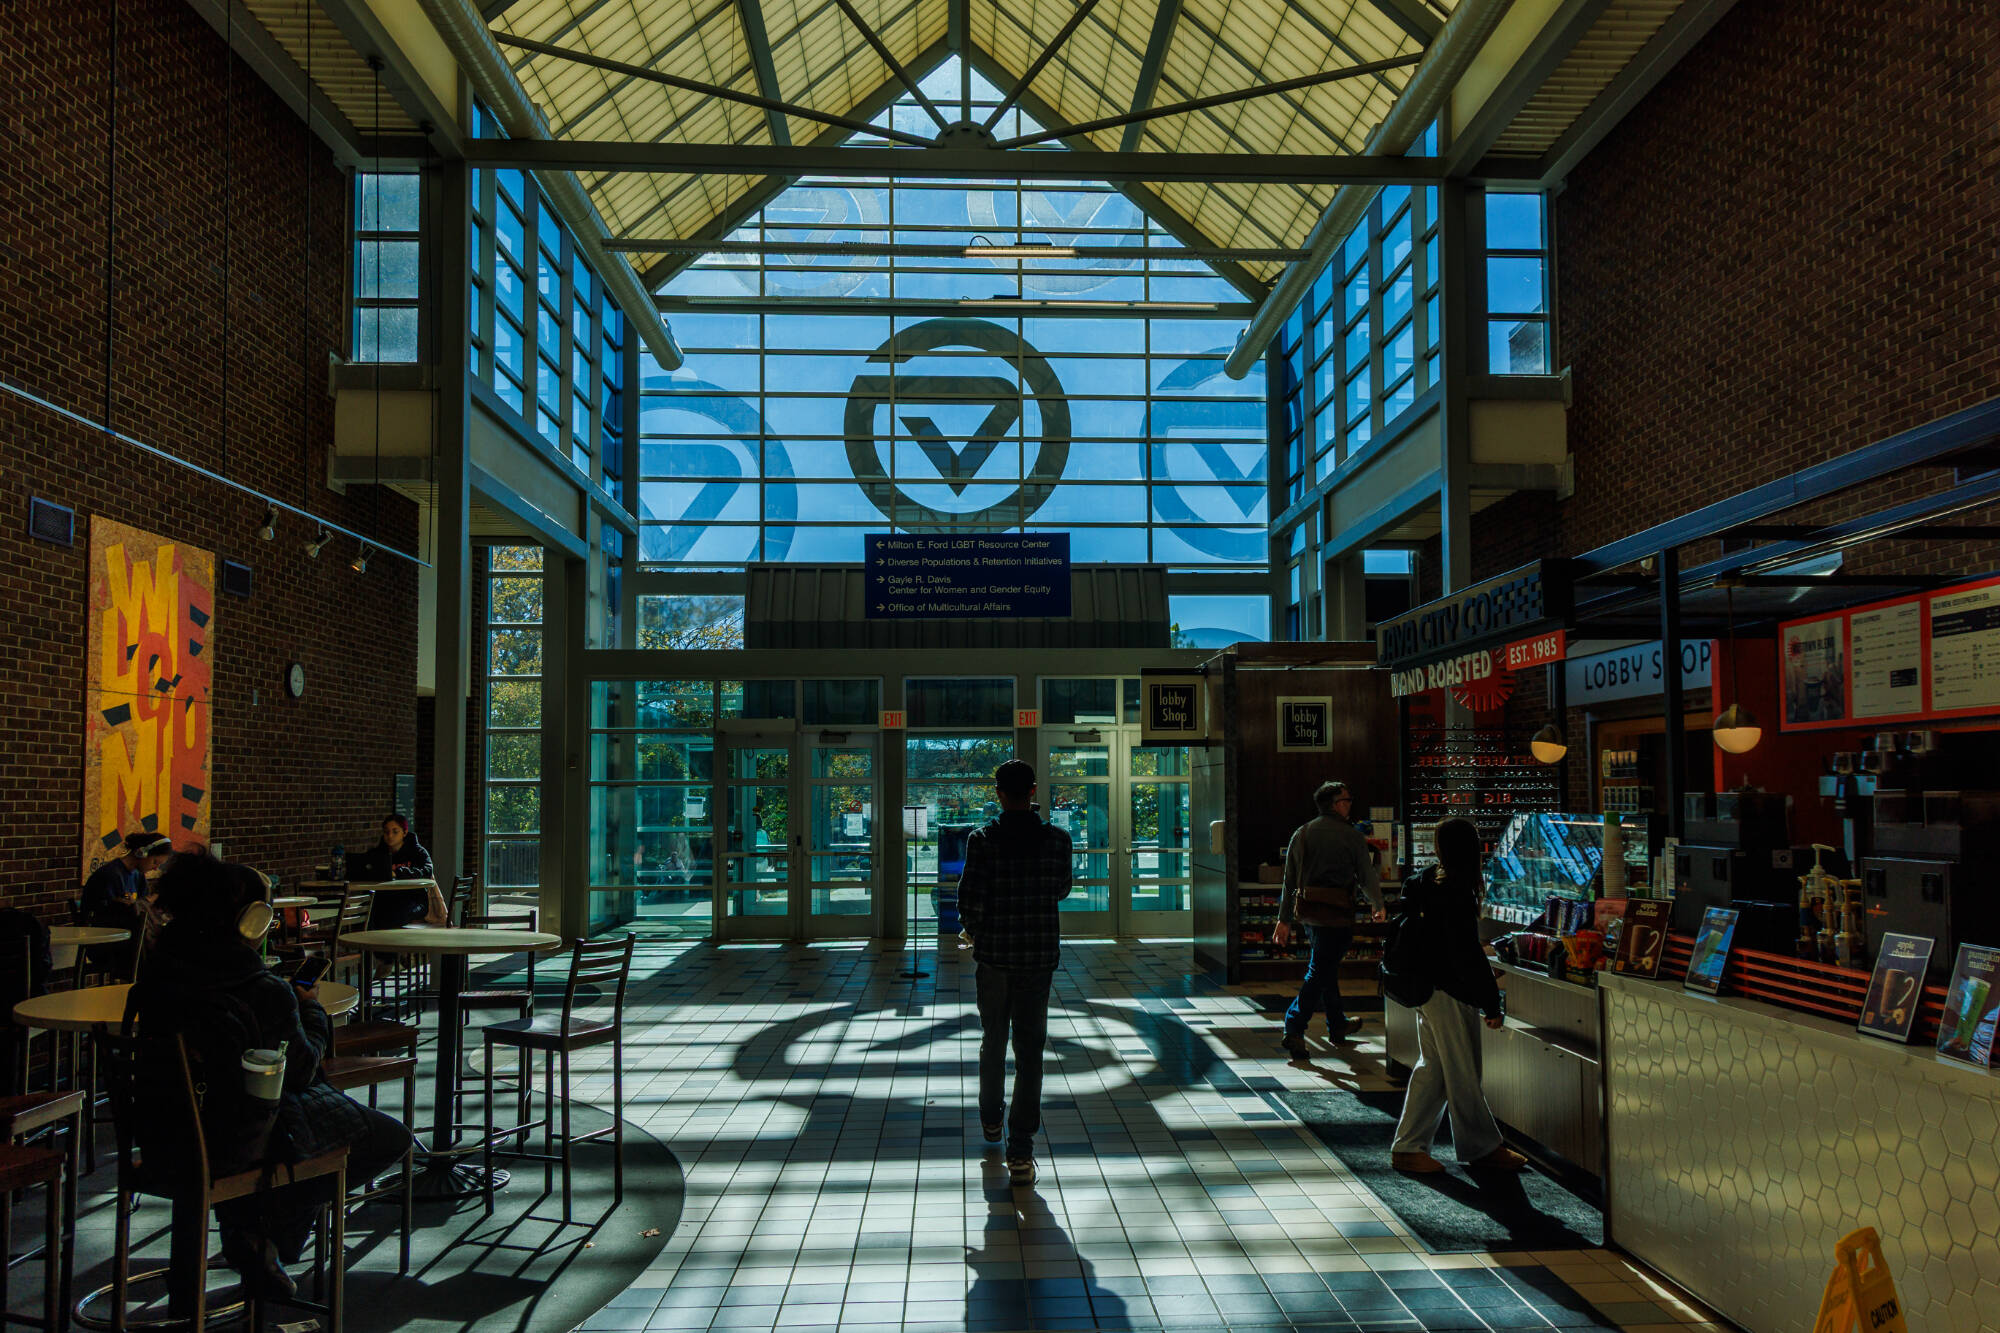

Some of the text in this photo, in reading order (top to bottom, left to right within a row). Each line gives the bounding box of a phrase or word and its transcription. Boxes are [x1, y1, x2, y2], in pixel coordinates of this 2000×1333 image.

[888, 539, 1050, 550] Milton E. Ford LGBT Resource Center
[888, 555, 1063, 568] Diverse Populations & Retention Initiatives
[888, 575, 951, 587] Gayle R. Davis
[888, 585, 1051, 596] Center for Women and Gender Equity
[888, 602, 1012, 613] Office of Multicultural Affairs
[1419, 603, 1459, 649] CITY
[1462, 573, 1545, 635] COFFEE
[1510, 637, 1558, 665] EST. 1985
[1585, 641, 1711, 690] LOBBY SOP
[1391, 650, 1493, 698] HAND ROASTED
[884, 712, 902, 727] EXIT
[1019, 711, 1037, 726] EXIT
[1162, 708, 1188, 731] Shop
[1294, 727, 1319, 746] Shop
